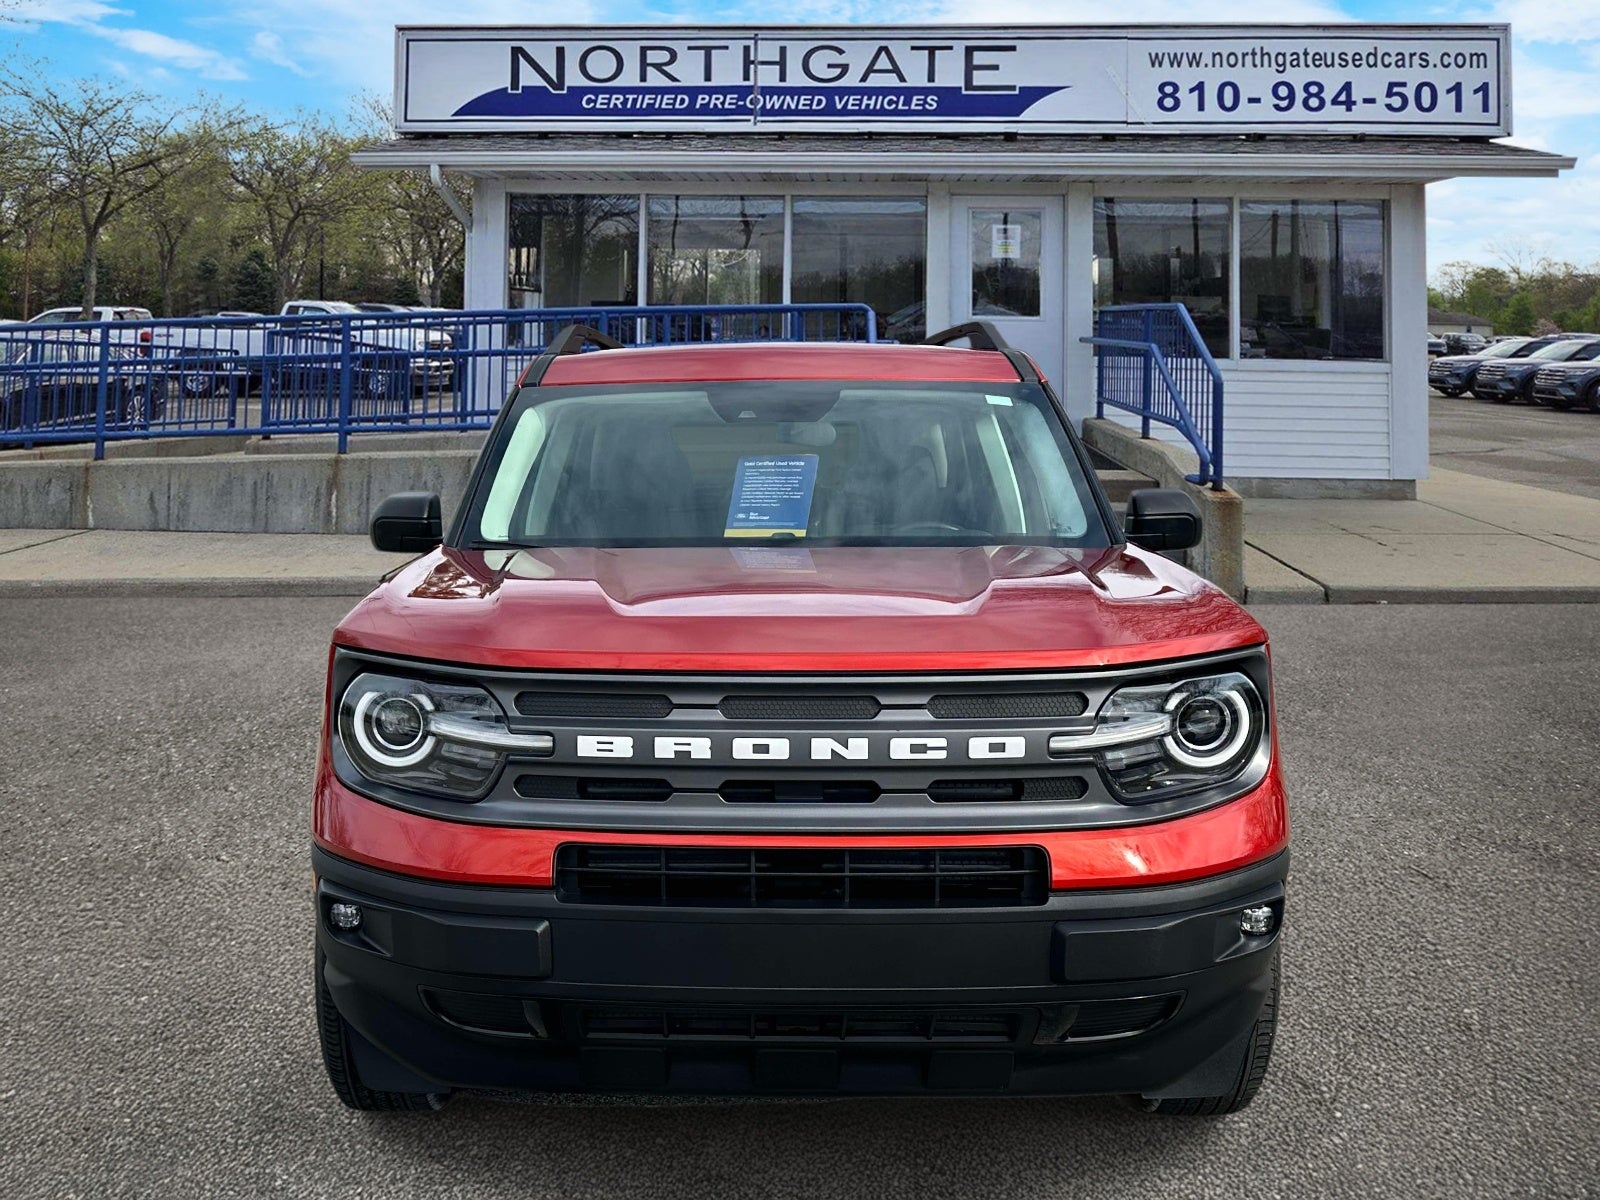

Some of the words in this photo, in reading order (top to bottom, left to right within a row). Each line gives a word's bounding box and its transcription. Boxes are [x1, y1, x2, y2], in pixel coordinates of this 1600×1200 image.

[510, 45, 1017, 92] NORTHGATE
[1148, 46, 1488, 74] www.northgateusedcars.com
[582, 94, 689, 109] CERTIFIED
[695, 94, 826, 110] PRE-OWNED
[834, 95, 938, 110] VEHICLES
[1156, 81, 1490, 113] 810-984-5011
[577, 735, 1026, 760] BRONCO
